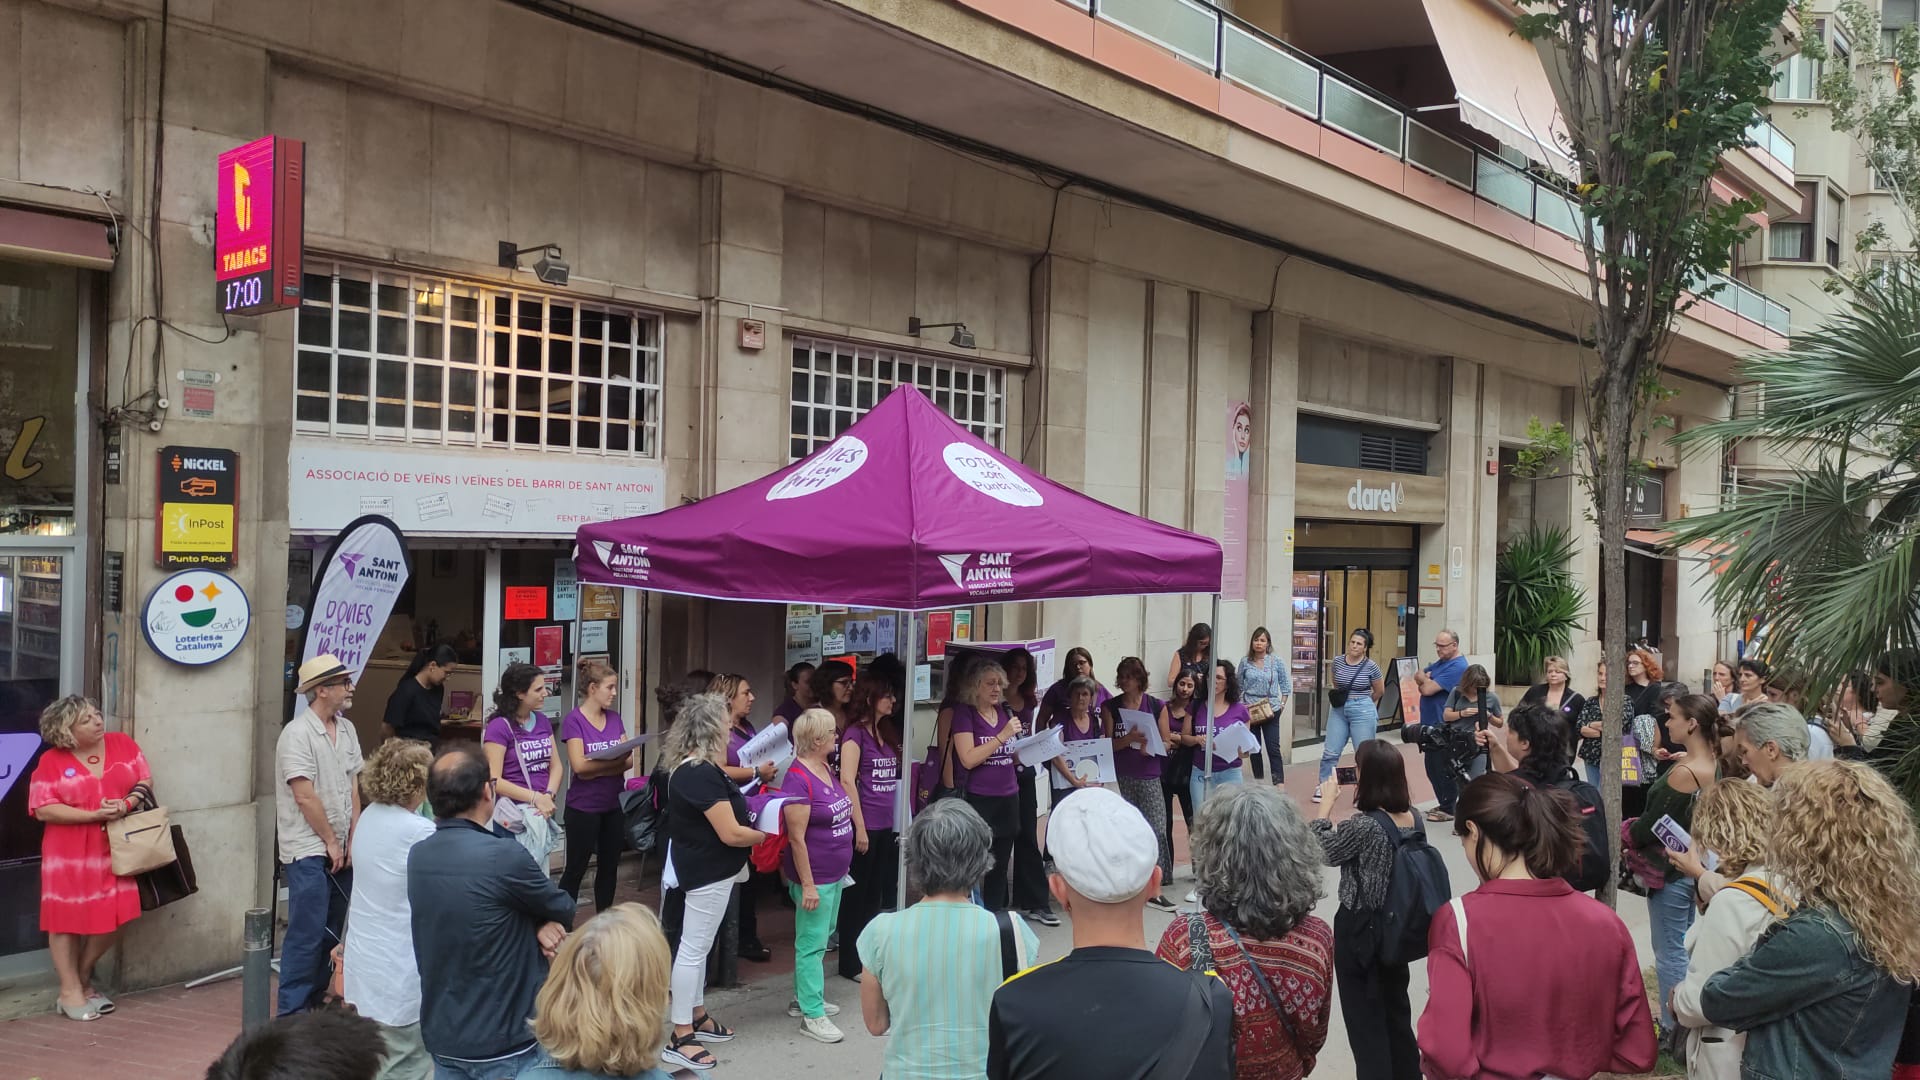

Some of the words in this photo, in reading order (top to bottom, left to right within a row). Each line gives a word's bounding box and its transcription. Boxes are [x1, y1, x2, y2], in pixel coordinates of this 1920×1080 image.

[223, 245, 267, 272] TABACS
[225, 277, 262, 310] 17:00
[306, 468, 390, 483] ASSOCIACIÓ
[393, 472, 411, 483] DE
[415, 472, 451, 485] VEÏNS
[462, 474, 504, 487] VEÏNES
[507, 477, 529, 489] DEL
[532, 478, 565, 489] BARRI
[568, 480, 582, 490] DE
[585, 481, 613, 491] SANT
[615, 482, 654, 494] ANTONI
[1347, 478, 1397, 513] clarel
[189, 518, 225, 530] InPost
[556, 513, 578, 523] FENT
[620, 543, 649, 556] SANT
[168, 555, 200, 563] Punto
[201, 555, 227, 563] Pack
[371, 556, 401, 571] SANT
[610, 554, 651, 568] ANTONI
[979, 552, 1012, 566] SANT
[358, 566, 399, 583] ANTONI
[966, 566, 1012, 582] ANTONI
[313, 620, 333, 640] que
[175, 634, 214, 644] Loteries
[342, 629, 366, 647] fem
[175, 641, 224, 652] Catalunya
[872, 758, 892, 768] TOTES
[872, 768, 890, 778] PUNT
